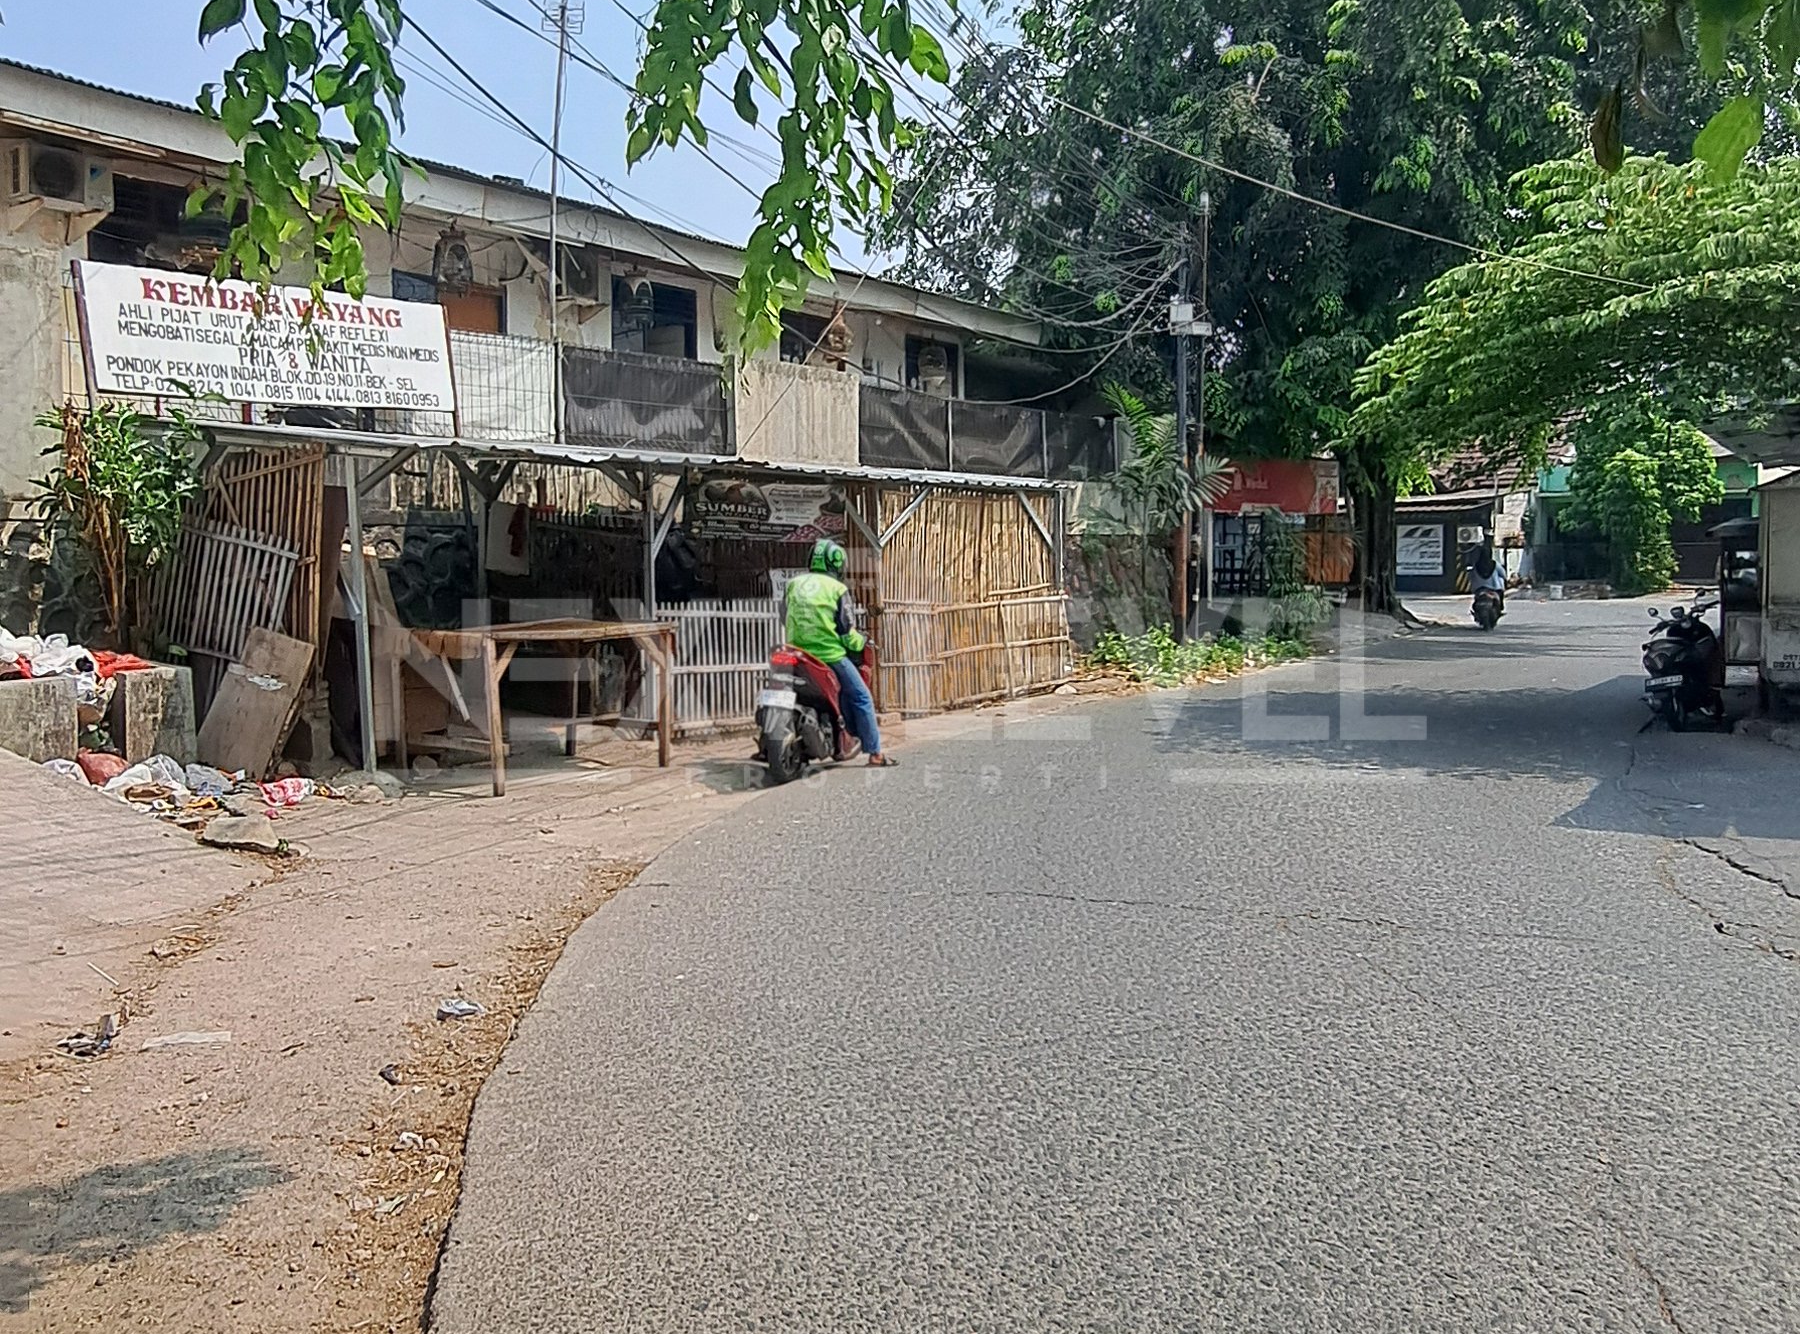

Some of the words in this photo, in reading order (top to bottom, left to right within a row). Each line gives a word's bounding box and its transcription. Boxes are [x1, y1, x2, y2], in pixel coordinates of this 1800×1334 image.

[119, 302, 152, 321] AHLI
[161, 307, 201, 326] PIJAT
[210, 312, 243, 330] URUT
[340, 325, 389, 342] REFLEXI
[239, 347, 277, 368] PRIA
[287, 352, 299, 370] &
[305, 352, 373, 375] WANITA
[352, 342, 386, 358] MEDIS
[409, 347, 440, 363] MEDIS
[106, 355, 164, 375] PONDOK
[167, 360, 229, 379] PEKAYON
[396, 377, 418, 391] SEL
[230, 382, 257, 398] 1041
[297, 386, 322, 402] 1104
[695, 502, 768, 516] SUMBER
